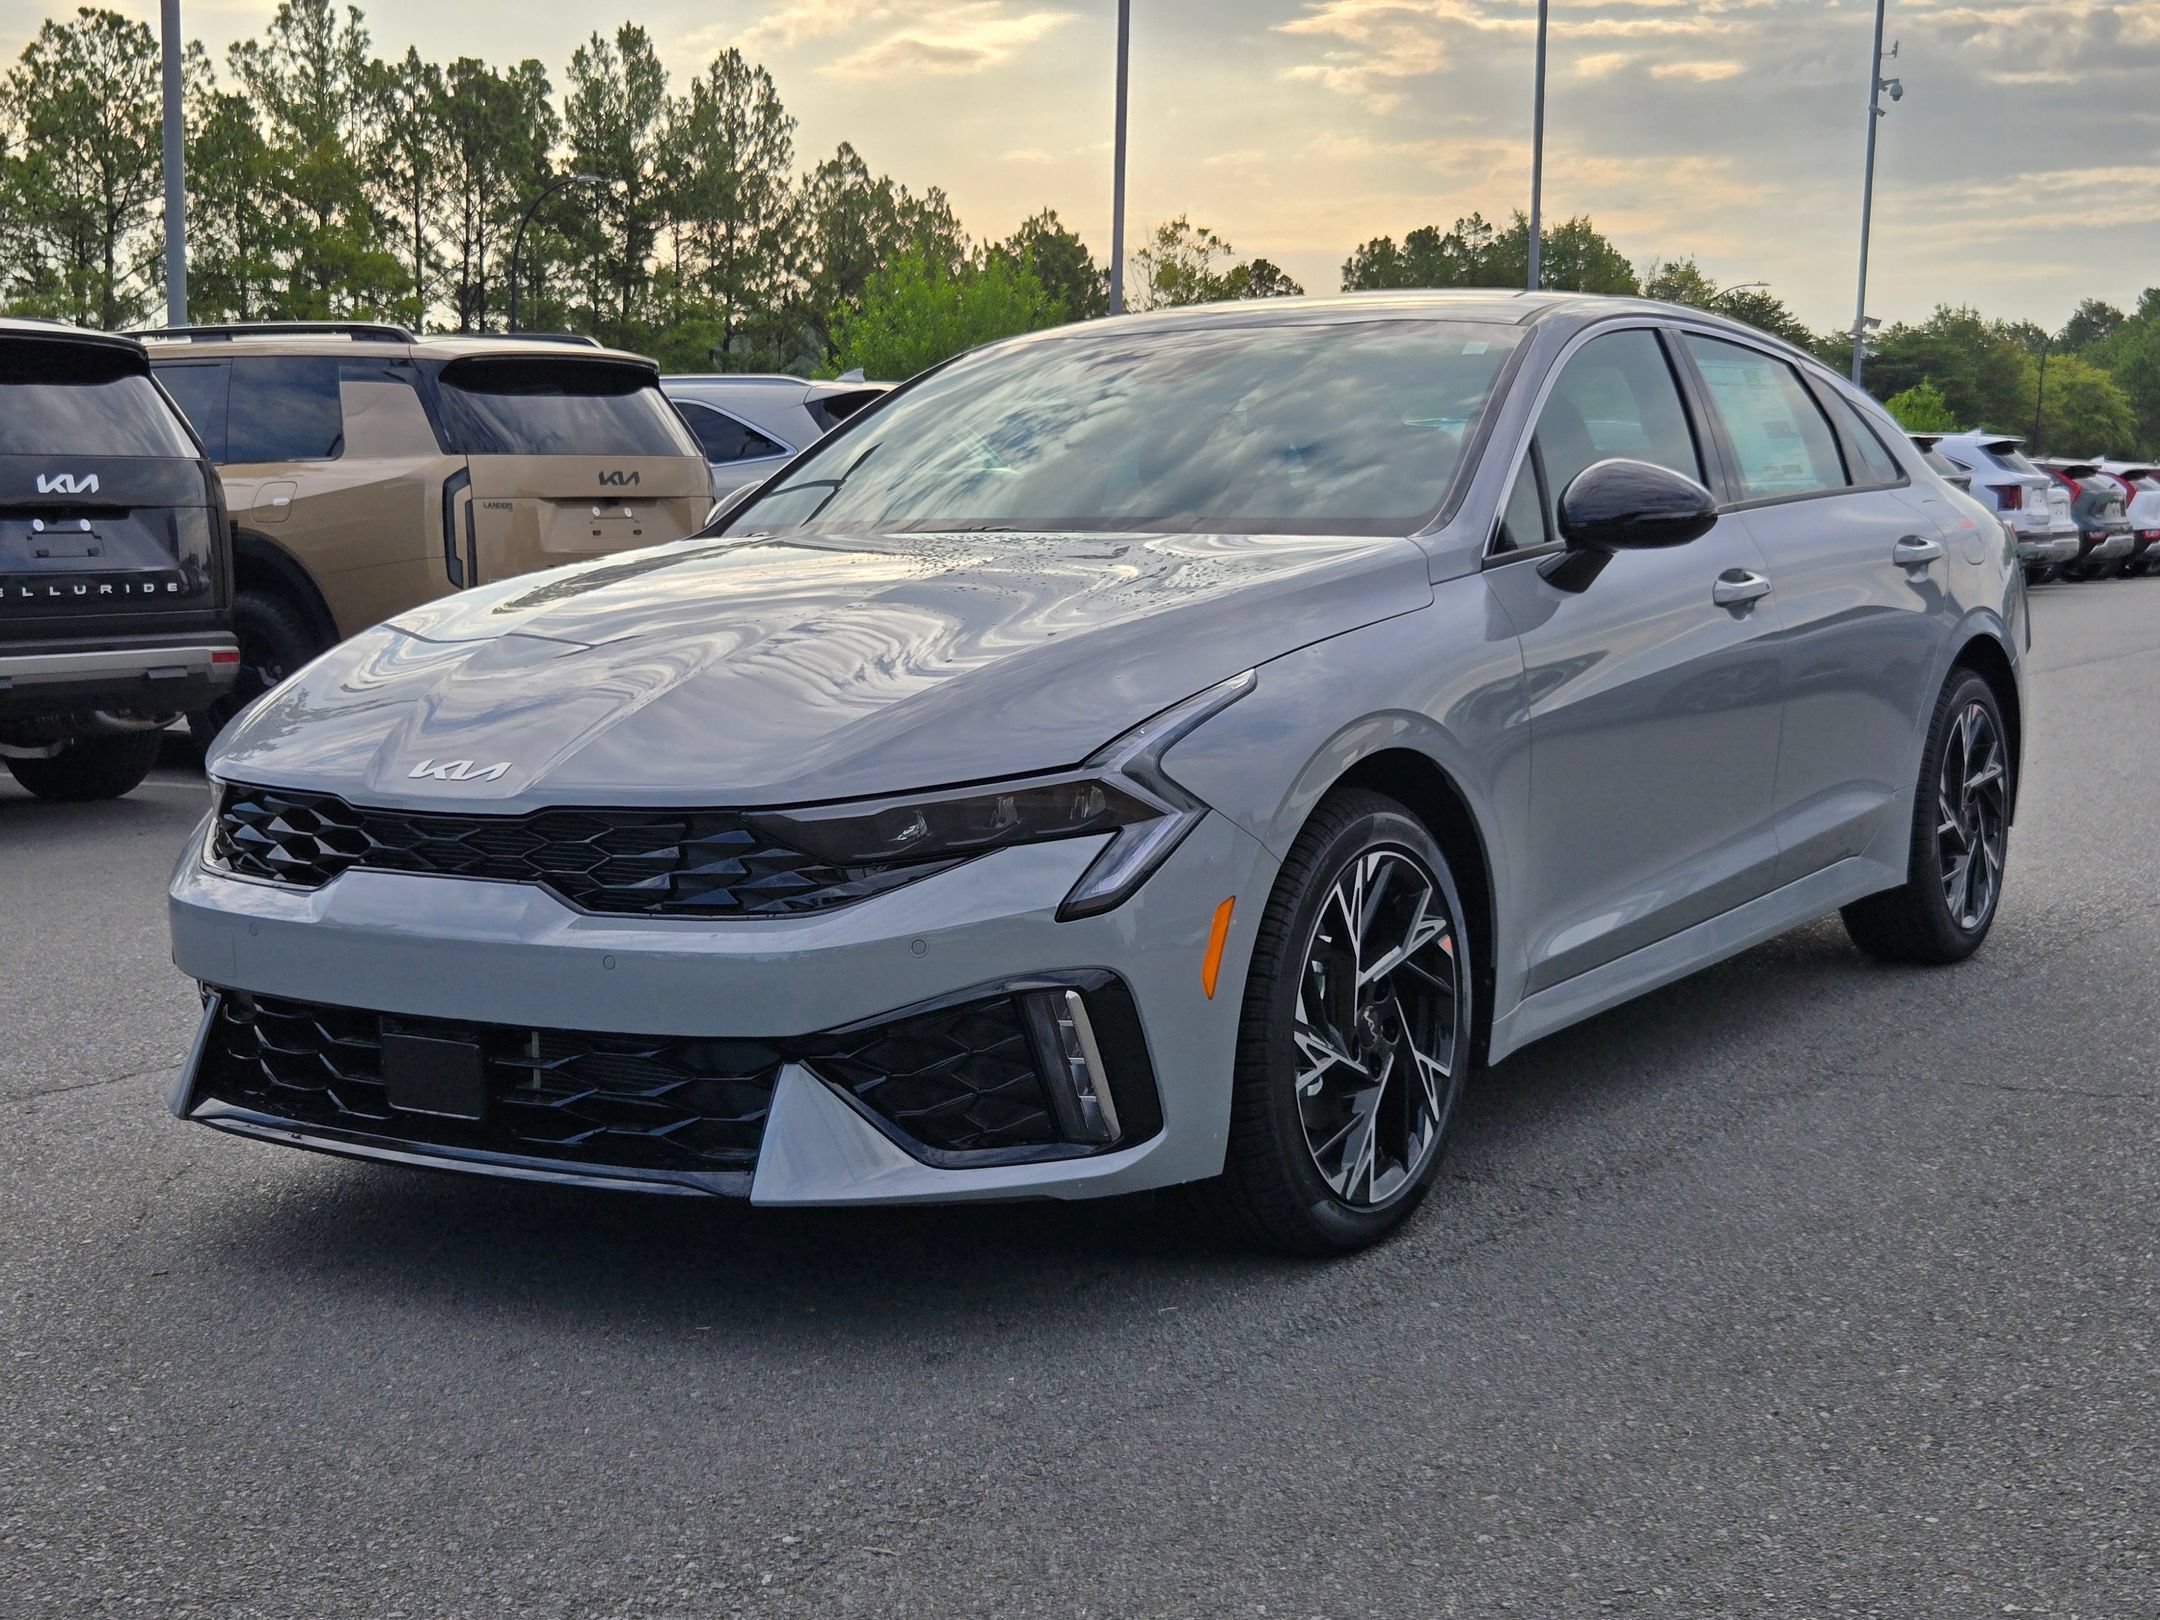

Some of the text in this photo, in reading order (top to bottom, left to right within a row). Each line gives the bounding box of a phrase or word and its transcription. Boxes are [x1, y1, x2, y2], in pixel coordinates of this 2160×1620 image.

[36, 473, 100, 493] KIA
[598, 470, 641, 486] KIA
[407, 758, 513, 782] KIA
